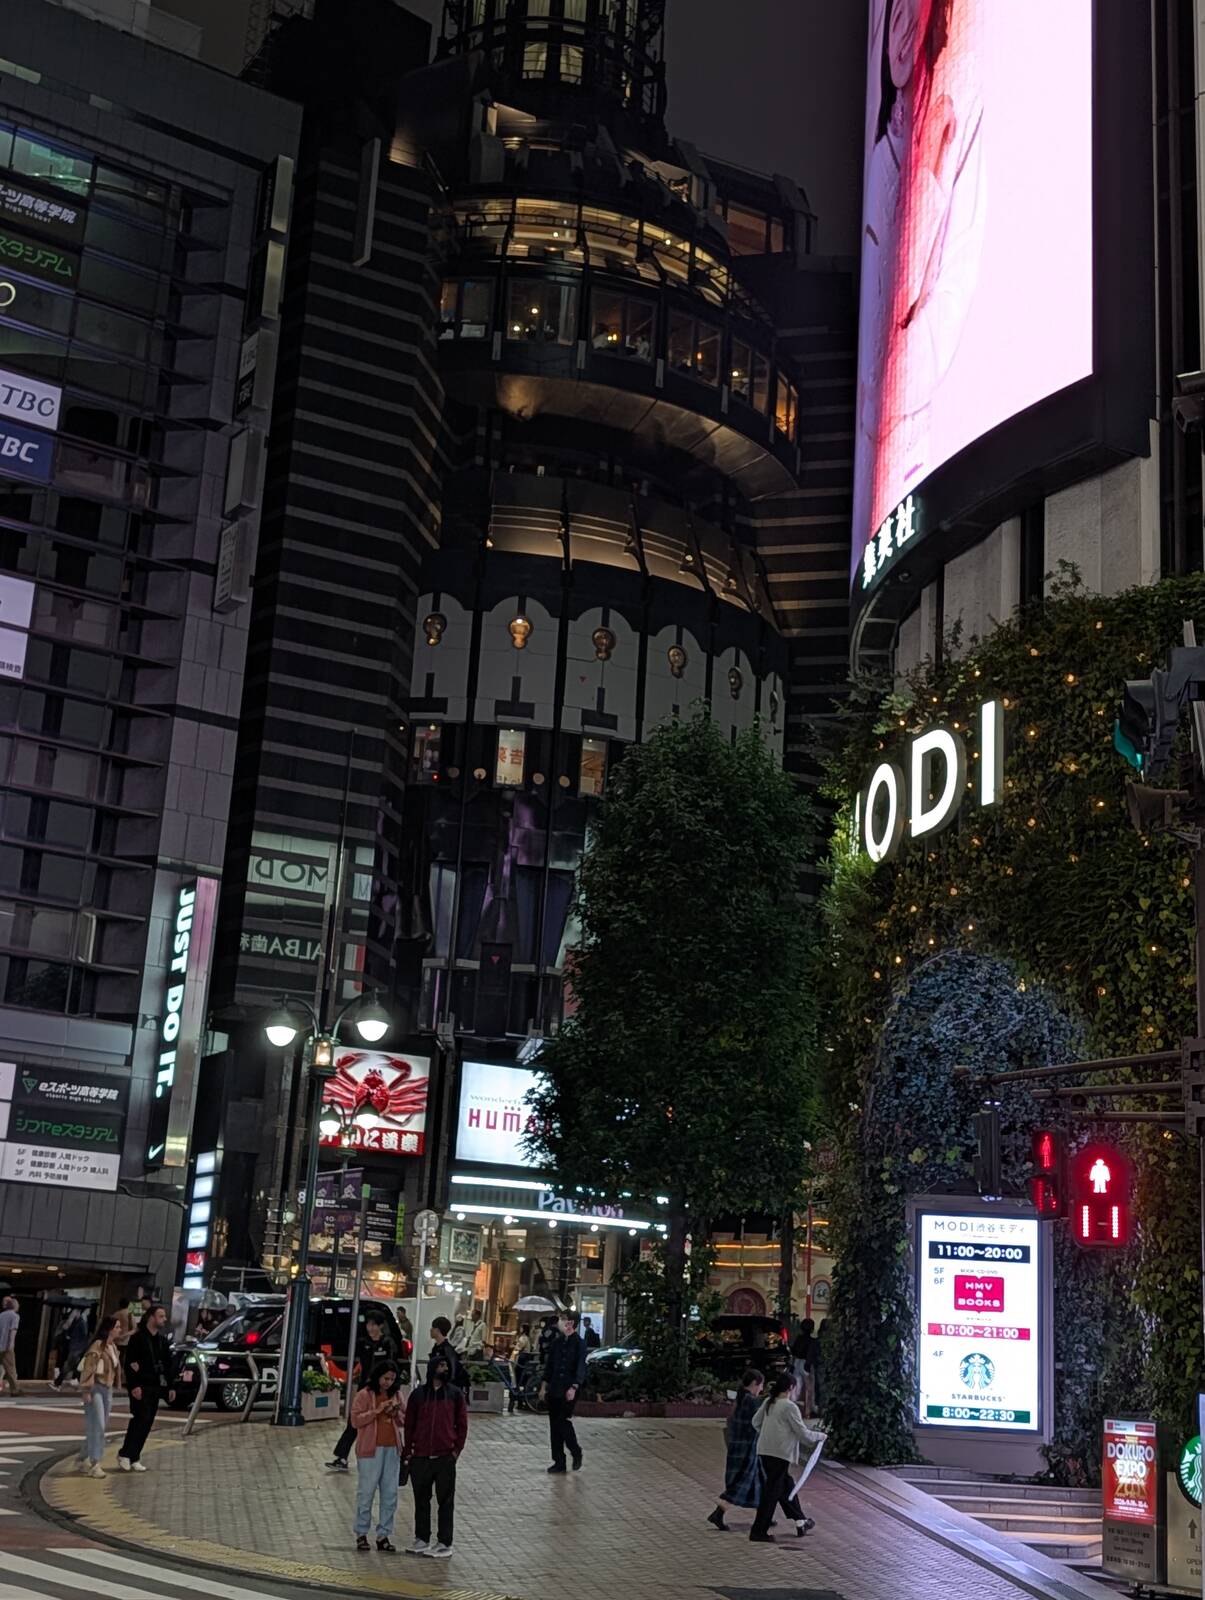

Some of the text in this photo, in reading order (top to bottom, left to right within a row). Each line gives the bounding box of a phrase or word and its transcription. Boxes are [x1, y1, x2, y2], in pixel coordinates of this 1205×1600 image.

[1, 384, 55, 416] TBC
[171, 887, 196, 974] JUST
[163, 984, 184, 1041] DO
[965, 1282, 993, 1290] HMV
[958, 1298, 1000, 1307] BOOKS
[951, 1393, 1003, 1402] STARBUCKS
[1107, 1442, 1155, 1462] DOKURO
[1115, 1459, 1147, 1478] EXPO
